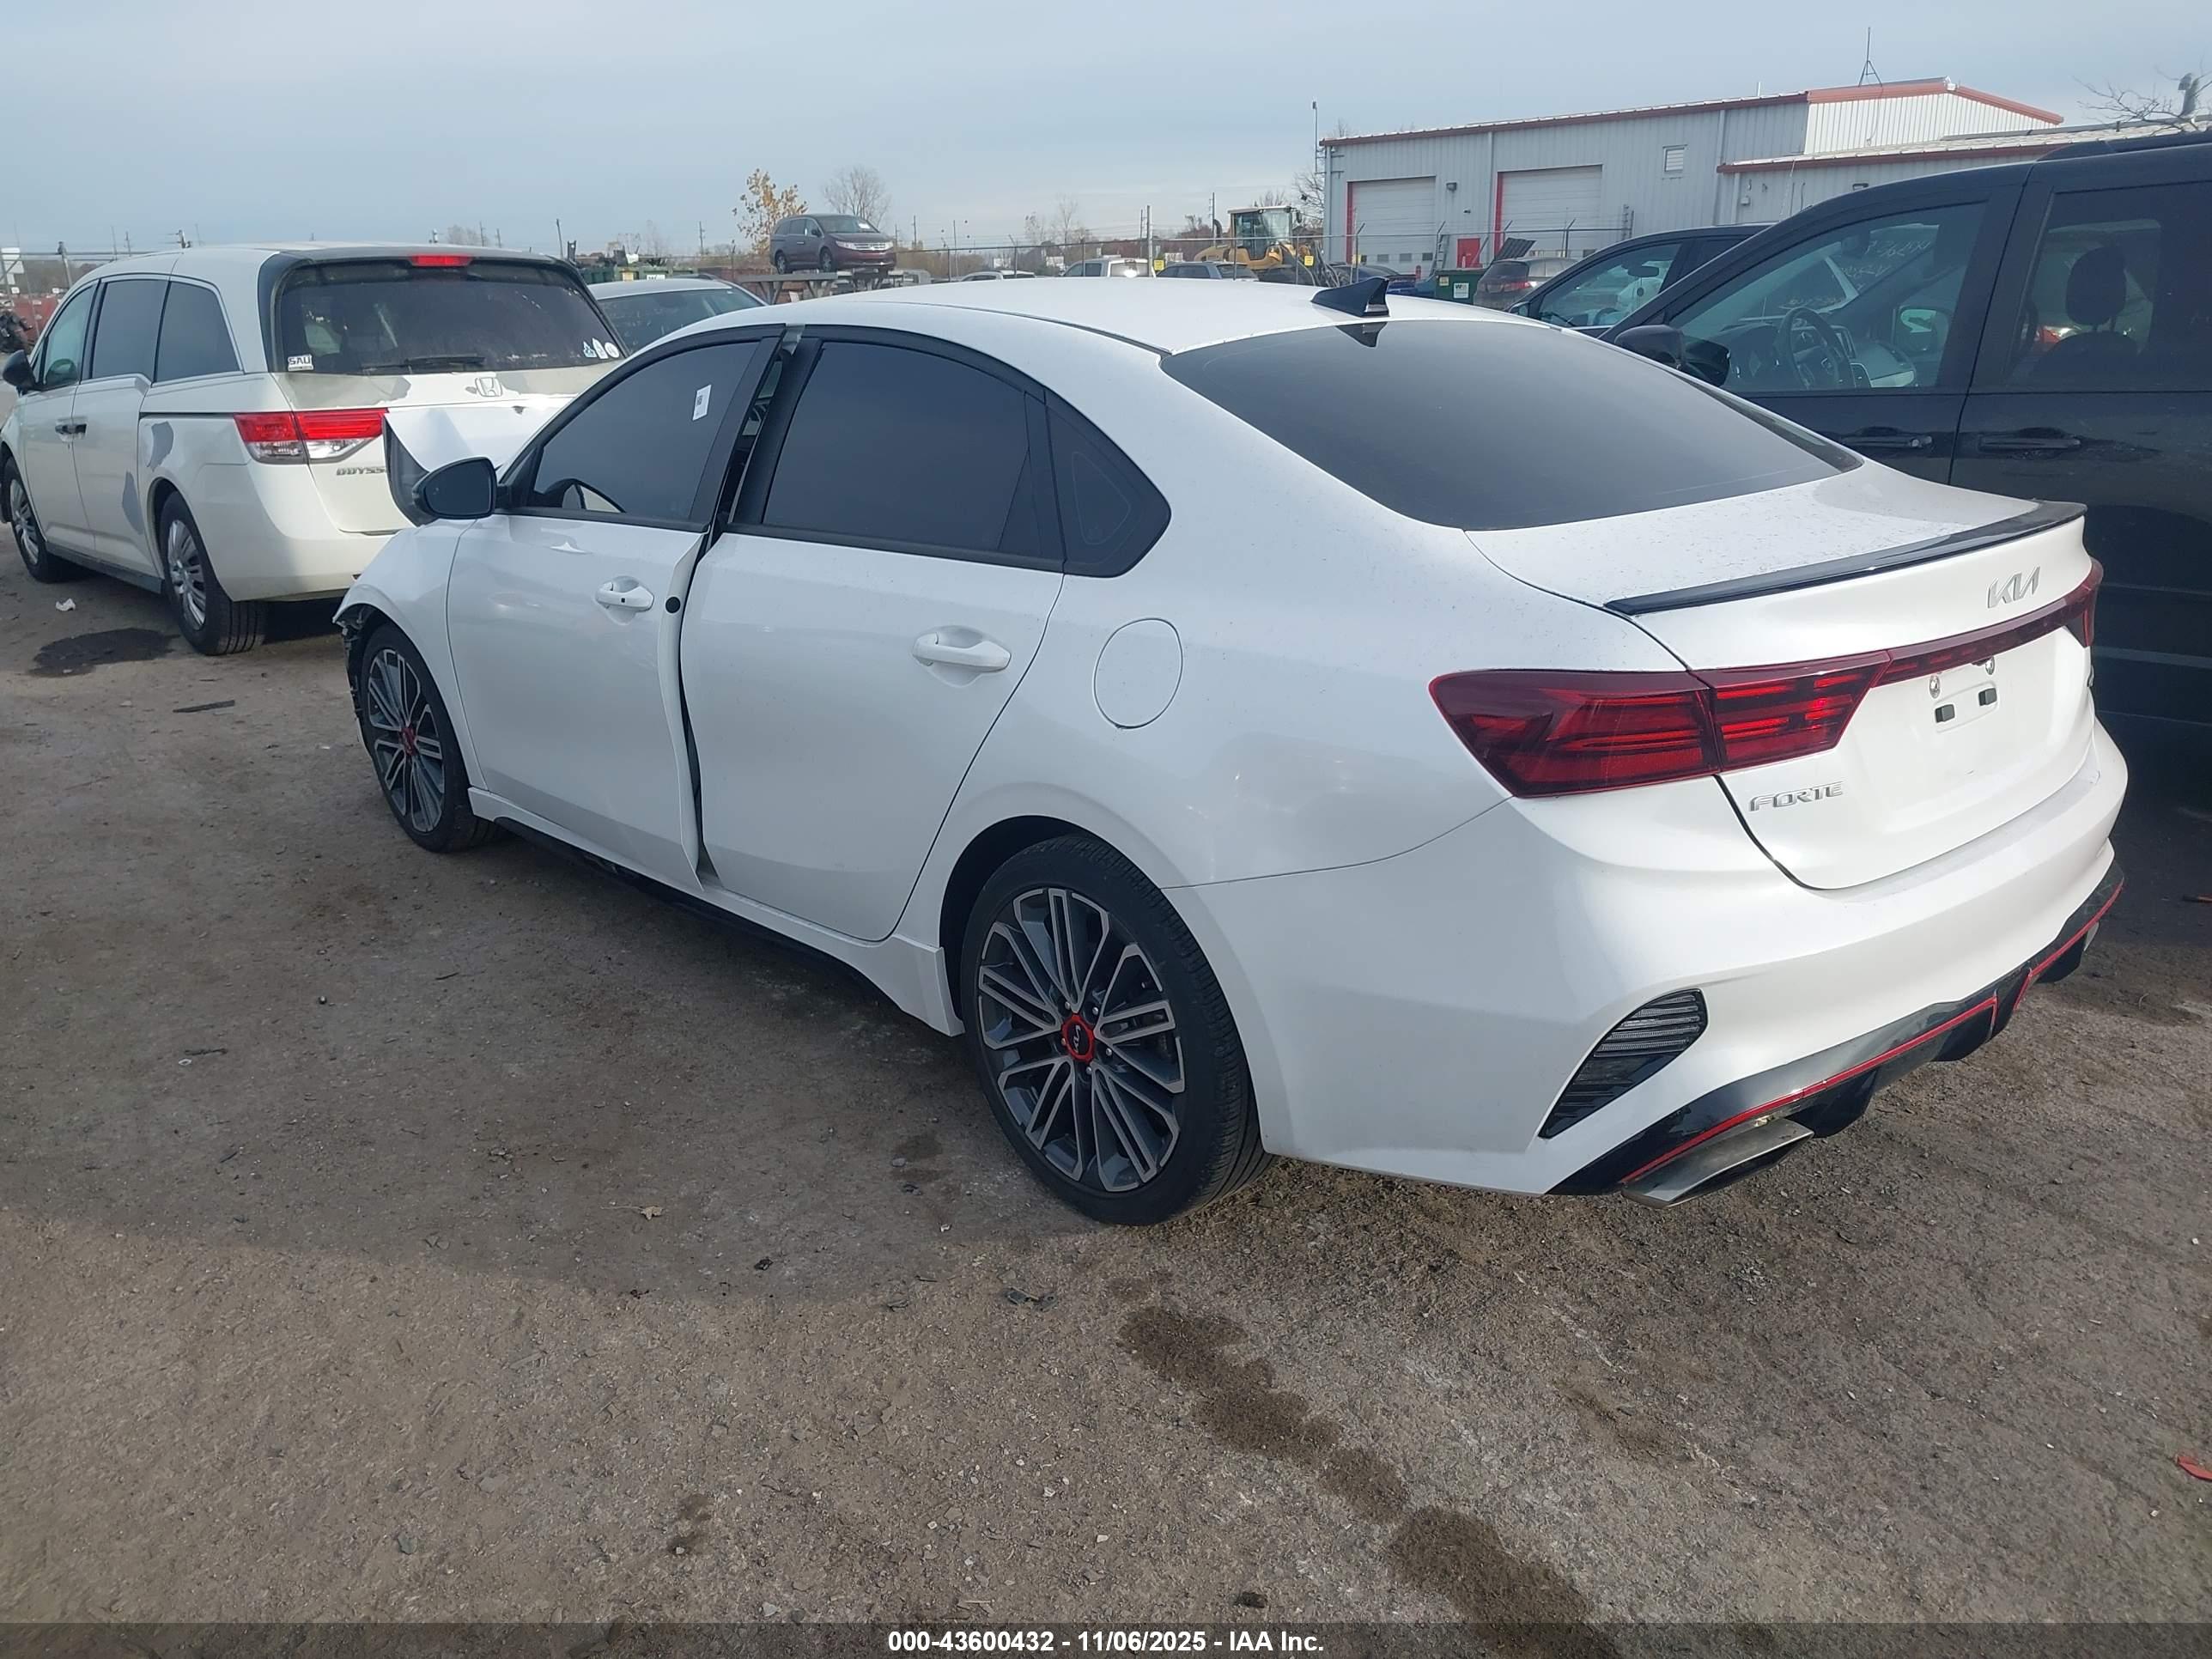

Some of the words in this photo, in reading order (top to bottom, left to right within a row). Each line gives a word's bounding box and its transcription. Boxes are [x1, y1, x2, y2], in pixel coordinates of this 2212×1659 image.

[336, 466, 386, 476] ODYSS
[1987, 566, 2040, 609] KIA
[1749, 781, 1844, 811] FORTE
